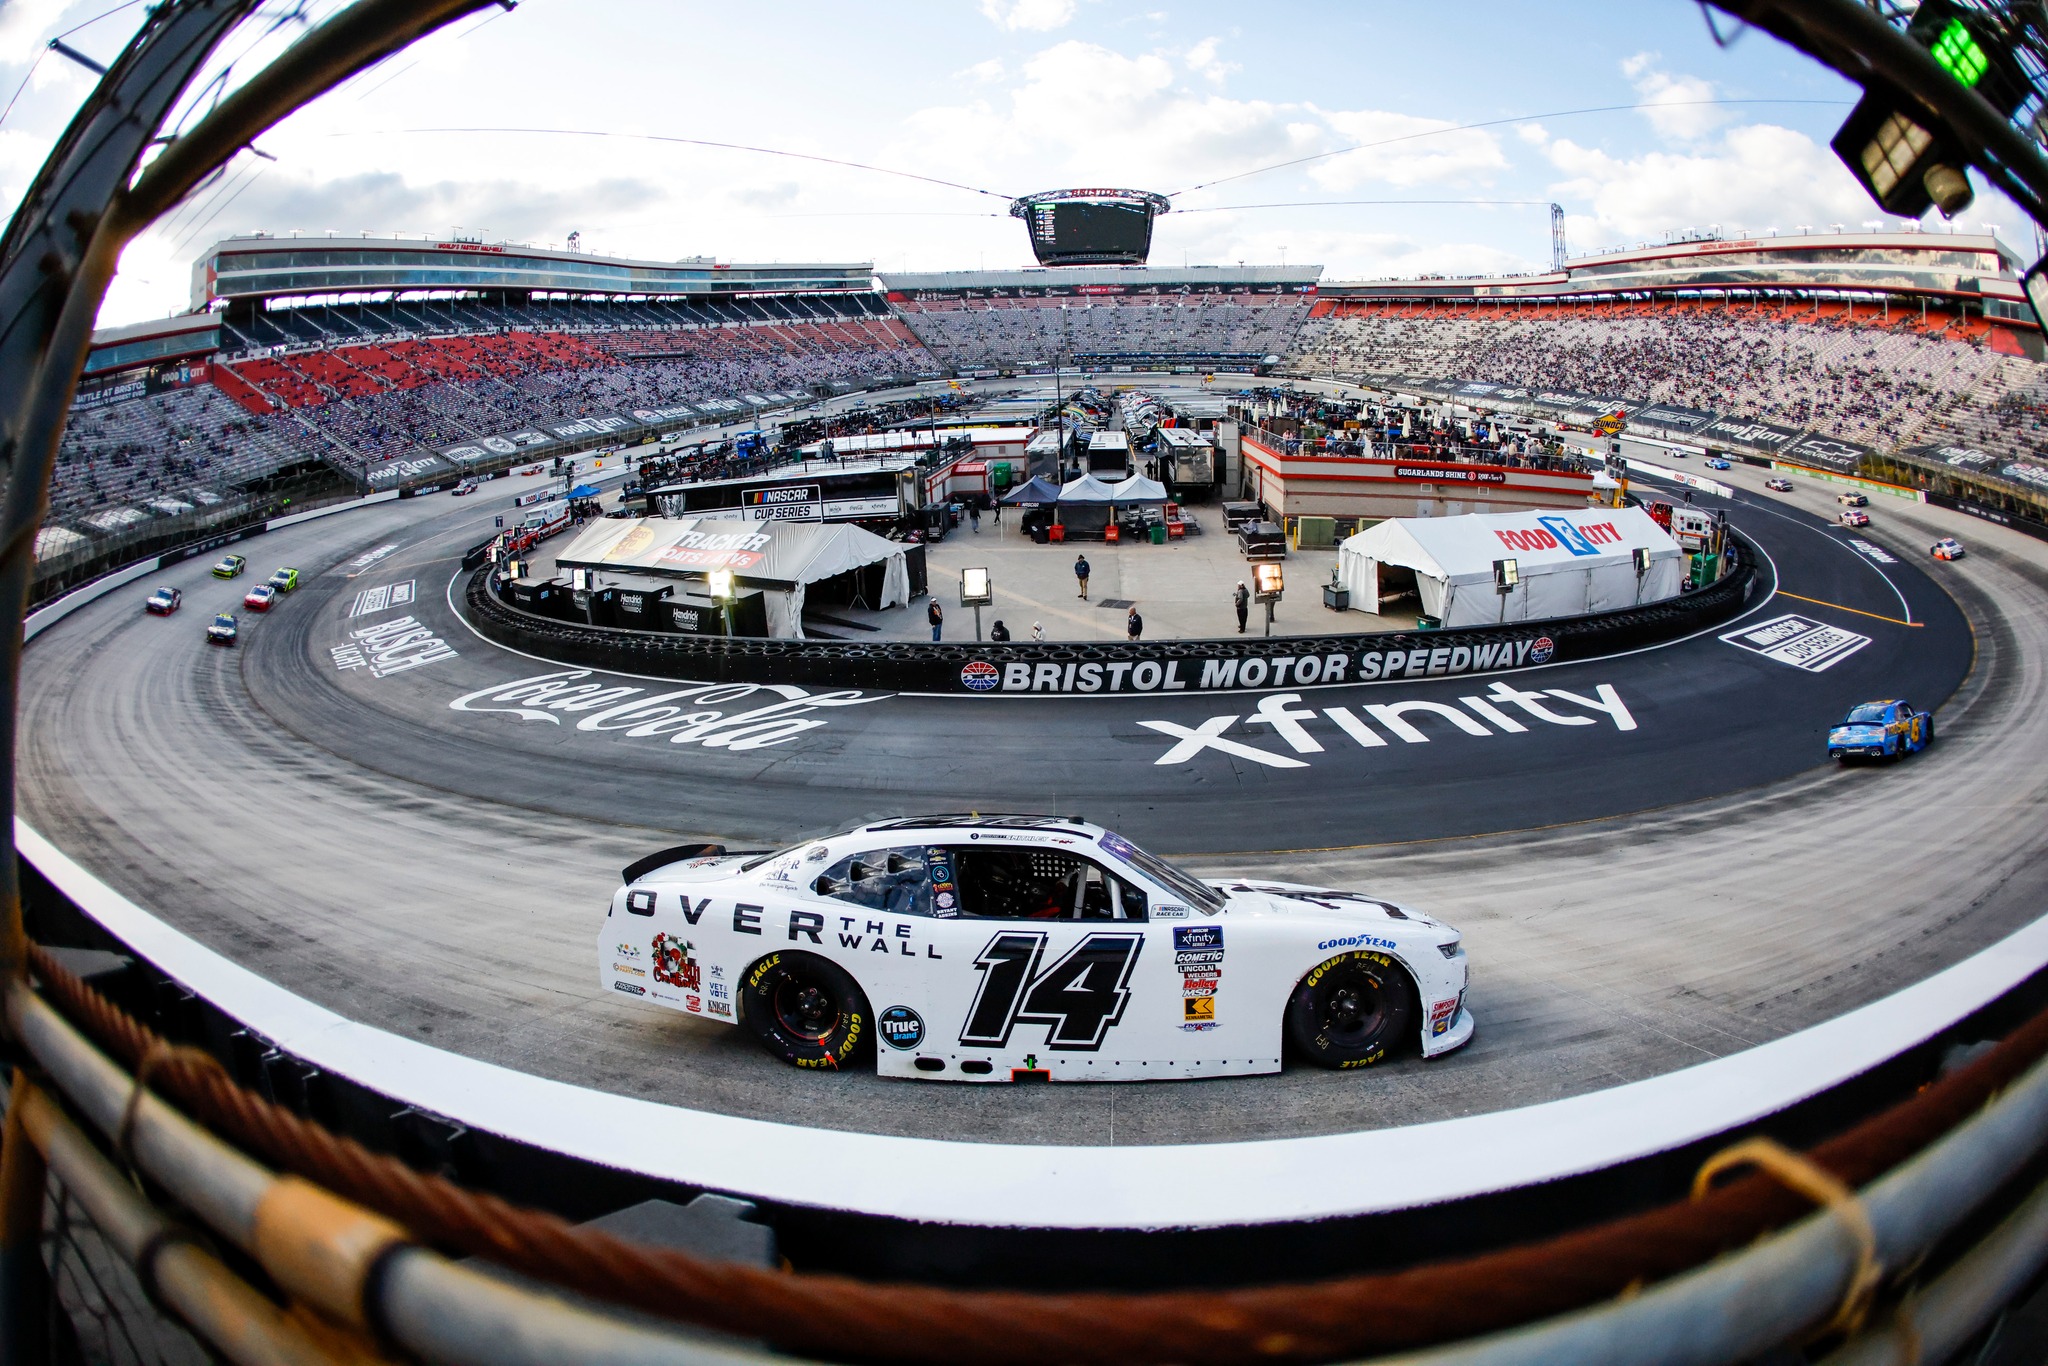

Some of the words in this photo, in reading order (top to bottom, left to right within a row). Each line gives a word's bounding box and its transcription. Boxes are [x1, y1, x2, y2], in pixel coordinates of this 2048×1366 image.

[1071, 188, 1118, 197] BRISTOL
[161, 372, 179, 384] FOOD
[190, 367, 205, 377] CITY
[102, 388, 112, 397] AT
[114, 381, 146, 393] BRISTOL
[553, 421, 590, 437] FOOD
[603, 416, 628, 428] CITY
[1595, 420, 1626, 430] SUNOCO
[1711, 422, 1743, 434] FOOD
[1758, 431, 1790, 443] CITY
[411, 456, 437, 471] CITY
[1792, 447, 1853, 465] CHEVROLET
[1398, 468, 1444, 478] SUGARLANDS
[1445, 471, 1466, 479] SHINE
[1674, 473, 1685, 482] FOOD
[1688, 477, 1697, 485] CITY
[525, 495, 536, 503] FOOD
[540, 490, 548, 499] CITY
[767, 488, 808, 502] NASCAR
[755, 508, 774, 520] CUP
[775, 505, 811, 518] SERIES
[678, 530, 772, 552] TRACKER
[1493, 525, 1559, 552] FOOD
[1580, 521, 1624, 544] CITY
[712, 549, 752, 566] ATVs
[603, 590, 612, 601] 24
[620, 593, 643, 605] Hendrick
[661, 590, 667, 599] 5
[672, 607, 699, 621] Hendrick
[1760, 619, 1811, 646] NASCAR
[349, 615, 460, 679] BUSCH
[1784, 641, 1815, 660] CUP
[1810, 630, 1845, 651] SERIES
[330, 643, 369, 672] LIGHT
[1003, 659, 1186, 692] BRISTOL
[1201, 652, 1348, 689] MOTOR
[1359, 639, 1533, 681] SPEEDWAY
[449, 670, 898, 751] Coca-Cola
[1135, 682, 1638, 768] xfinity
[626, 889, 825, 944] OVER
[840, 917, 912, 938] THE
[838, 933, 943, 959] WALL
[1182, 934, 1215, 945] xfinity
[1318, 934, 1397, 950] GOODYEAR
[1177, 951, 1222, 962] COMETIC
[750, 953, 781, 987] EAGLE
[1180, 964, 1214, 973] LINCOLN
[1307, 950, 1391, 987] GOODYEAR
[709, 982, 723, 991] VET
[958, 930, 1145, 1051] 14
[1184, 979, 1218, 990] Holley
[710, 989, 729, 999] VOTE
[1182, 988, 1212, 997] MSD
[708, 999, 731, 1013] KNIGHT
[1432, 998, 1456, 1012] SIMPSON
[883, 1018, 919, 1033] True
[893, 1031, 918, 1041] Brand
[1339, 1048, 1385, 1069] EAGLE
